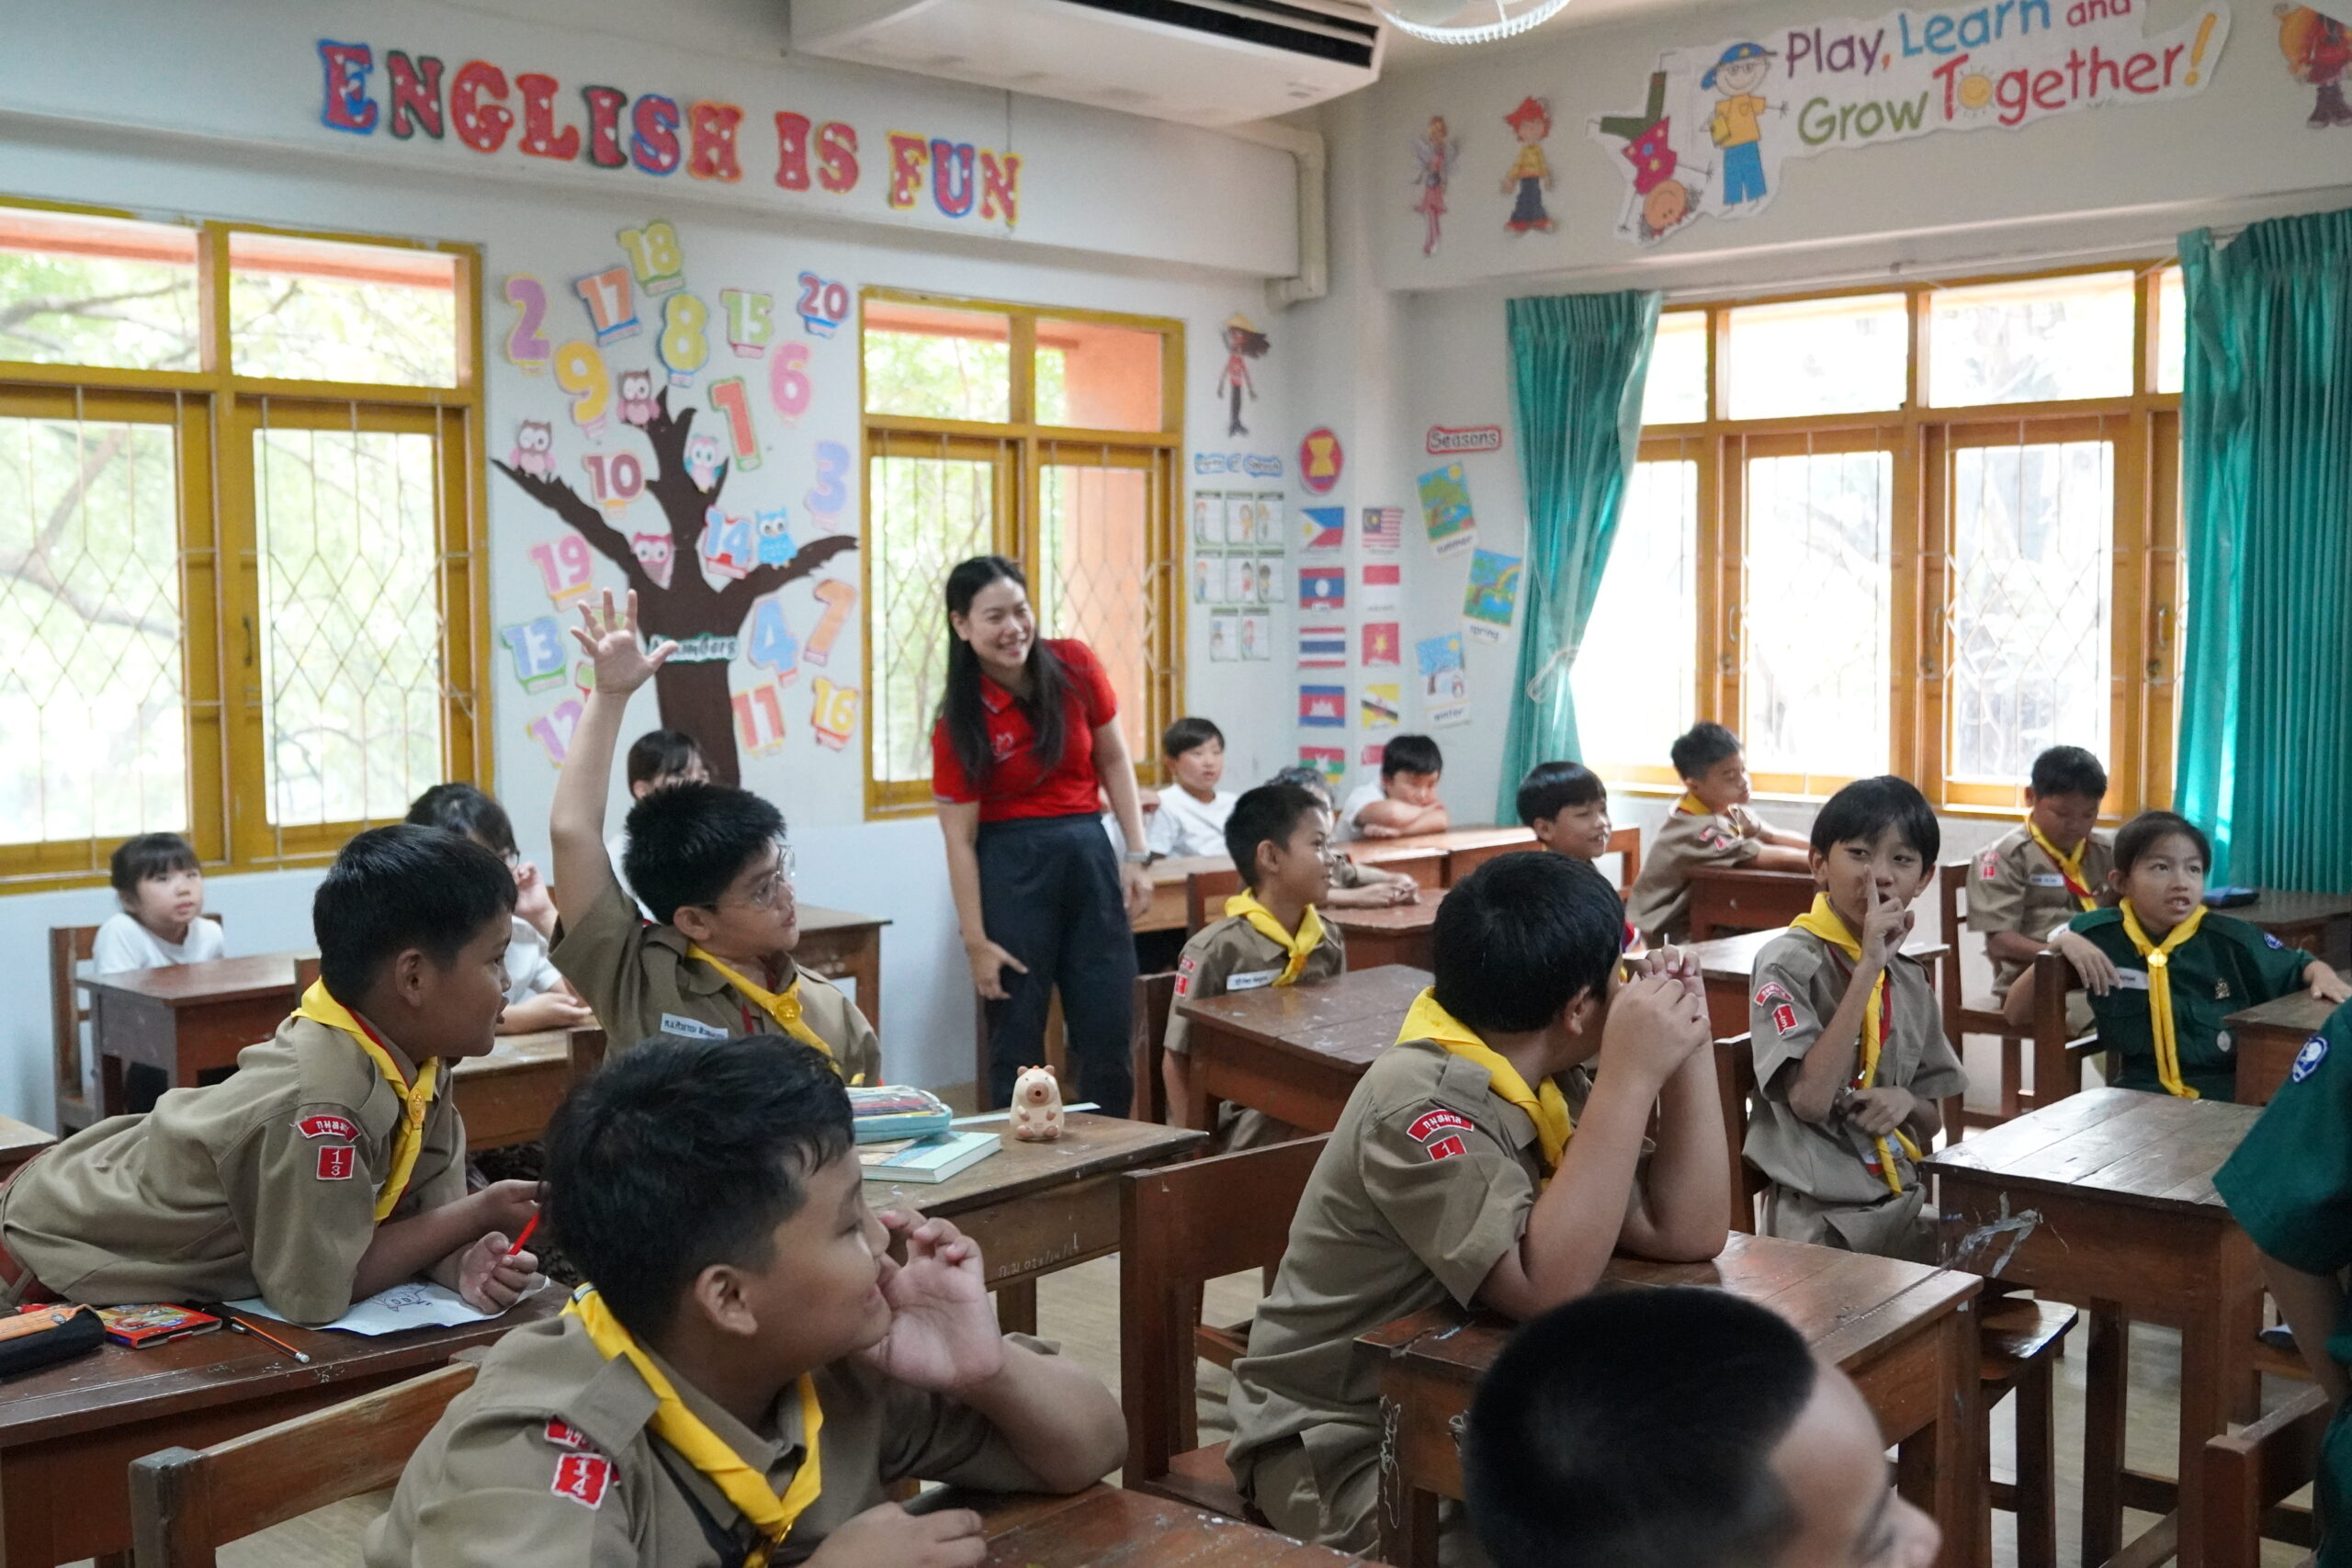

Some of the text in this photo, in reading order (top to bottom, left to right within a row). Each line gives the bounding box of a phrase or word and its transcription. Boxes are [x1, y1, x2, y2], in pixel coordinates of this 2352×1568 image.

[1787, 28, 1892, 78] Play,
[1899, 0, 2051, 55] Learn
[317, 39, 1023, 223] ENGLISH IS FUN
[1798, 91, 1928, 145] Grow
[619, 220, 682, 277] 18
[505, 275, 551, 364] 2
[575, 267, 634, 329] 17
[722, 290, 774, 347] 15
[798, 273, 850, 319] 20
[661, 292, 708, 372] 8
[555, 341, 611, 423] 9
[770, 343, 812, 416] 6
[712, 379, 756, 457] 1
[1431, 430, 1497, 449] Seasons
[585, 453, 644, 502] 10
[807, 442, 851, 513] 3
[530, 536, 593, 592] 19
[705, 509, 752, 566] 14
[651, 636, 736, 654] mbers
[751, 597, 800, 675] 4
[805, 580, 856, 654] 7
[504, 618, 565, 679] 13
[734, 685, 786, 750] 11
[813, 679, 857, 733] 16
[331, 1165, 341, 1177] 3
[332, 1149, 341, 1163] 1
[571, 1477, 587, 1496] 4
